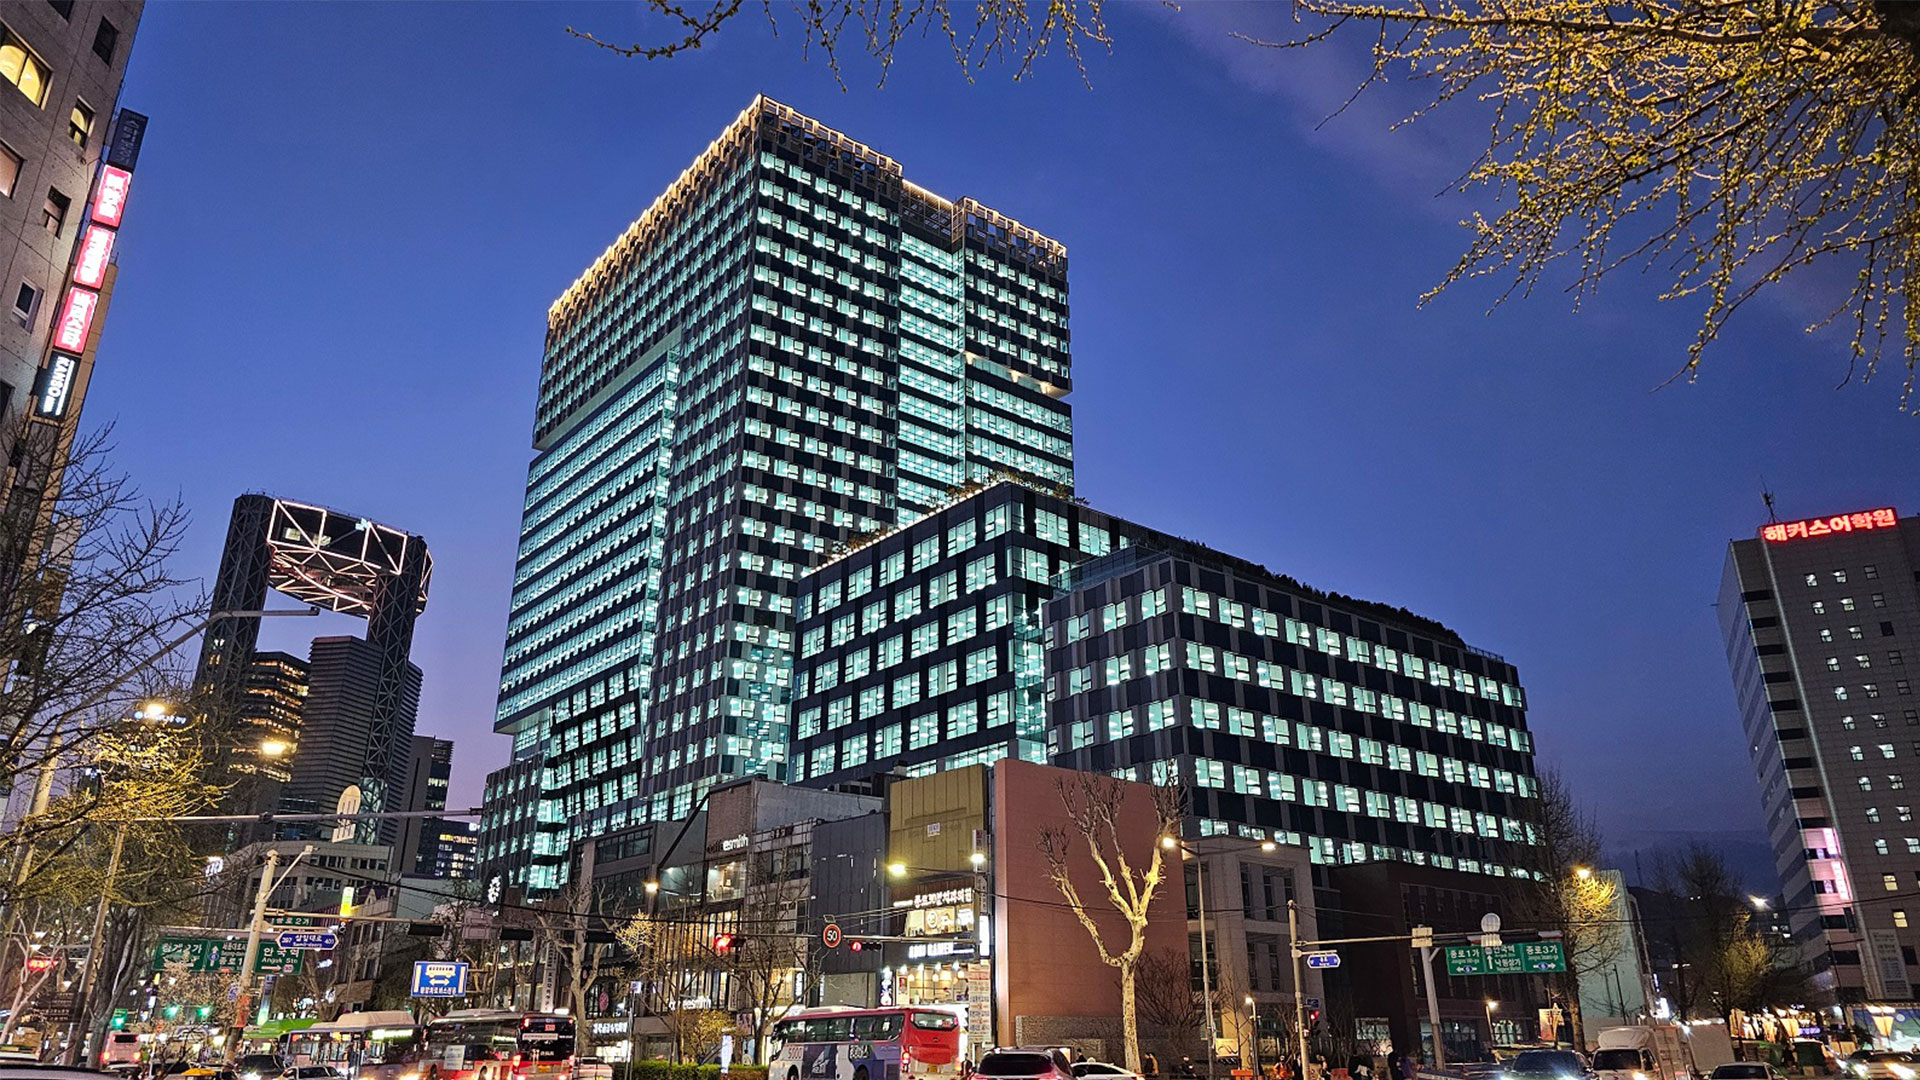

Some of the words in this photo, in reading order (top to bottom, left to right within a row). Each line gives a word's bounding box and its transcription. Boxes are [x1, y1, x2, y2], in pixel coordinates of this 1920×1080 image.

[1764, 509, 1896, 541] 해커스어학원
[295, 934, 322, 942] 삼일대로
[827, 930, 838, 941] 50
[263, 947, 299, 957] 안국역
[1451, 949, 1480, 959] 종로1가
[1526, 944, 1558, 955] 종로3가
[219, 956, 243, 966] 종로1
